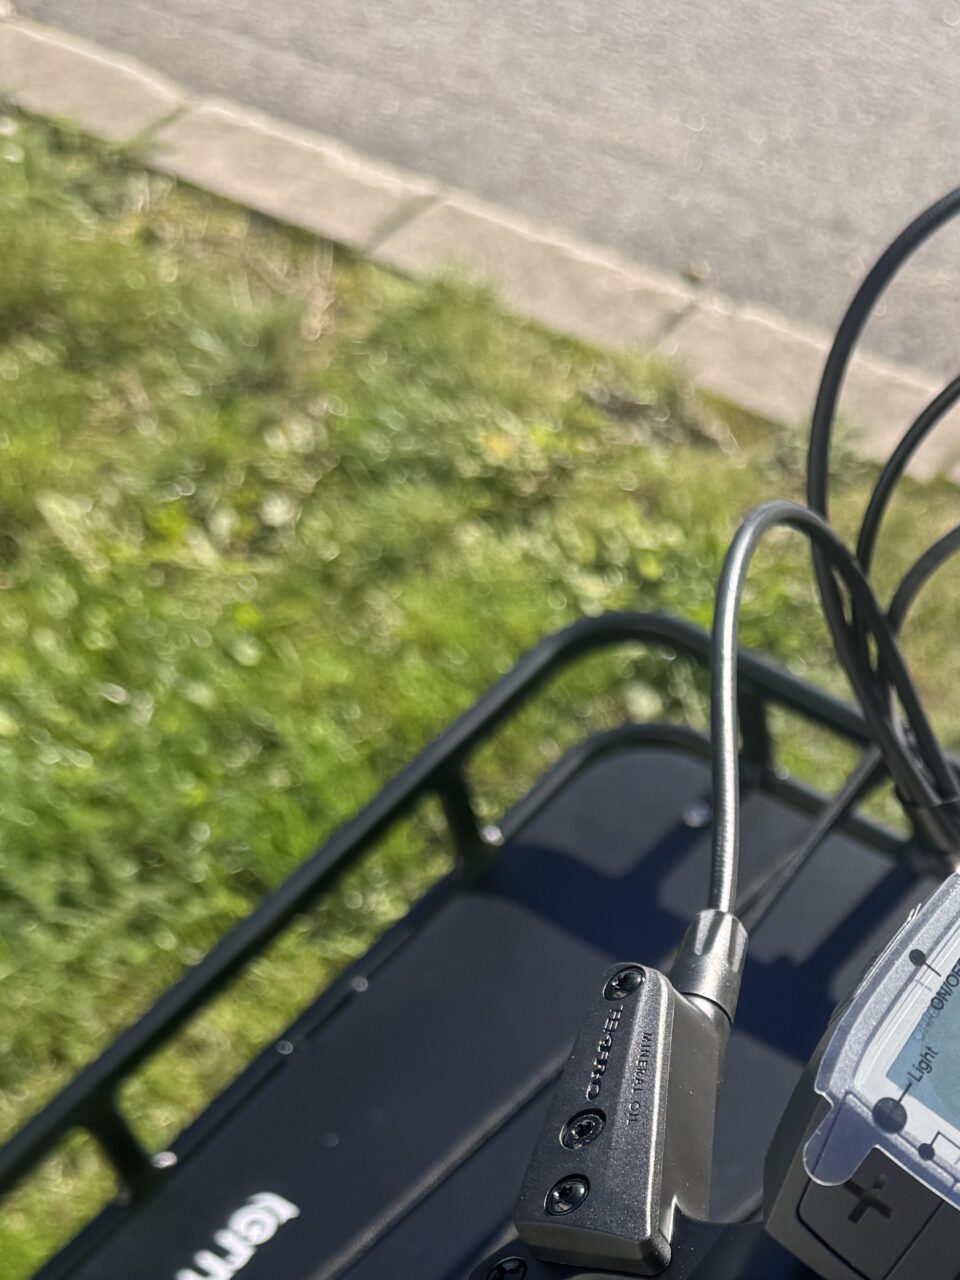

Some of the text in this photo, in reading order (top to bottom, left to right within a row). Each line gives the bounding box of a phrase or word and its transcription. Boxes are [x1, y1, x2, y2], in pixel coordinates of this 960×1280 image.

[627, 1032, 653, 1124] MINERAL OIL
[907, 1046, 938, 1083] Light
